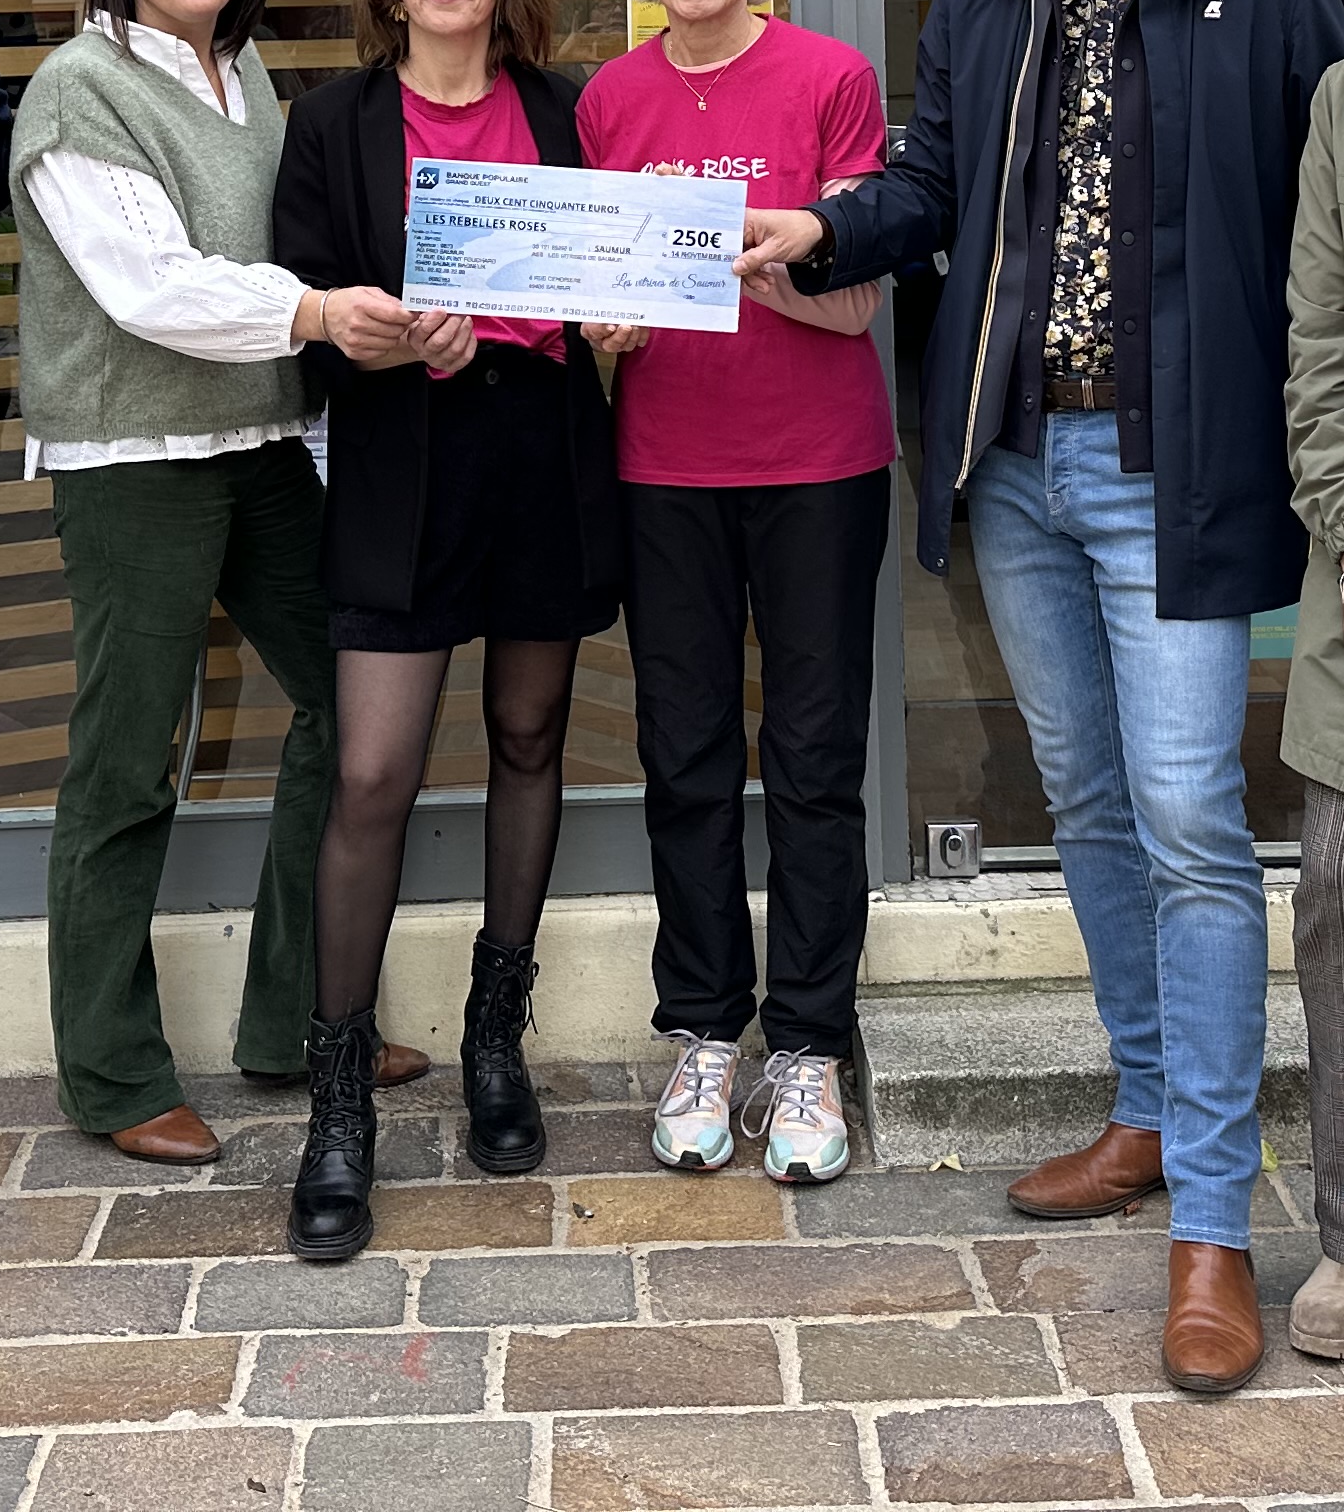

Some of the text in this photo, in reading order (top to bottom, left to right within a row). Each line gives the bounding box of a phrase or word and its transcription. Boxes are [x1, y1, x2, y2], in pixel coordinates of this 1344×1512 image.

[701, 155, 770, 179] ROSE
[446, 172, 529, 184] BANQUE POPULAIRE
[474, 196, 501, 206] DEUX
[503, 197, 527, 208] CENT
[529, 199, 586, 213] CINQUANTE
[588, 204, 620, 214] EUROS
[425, 214, 547, 232] LES REBELLES ROSES
[672, 229, 722, 248] 250€
[594, 244, 631, 255] SAUMUR
[612, 272, 632, 290] Les
[669, 276, 680, 287] de
[682, 273, 726, 289] Saumur
